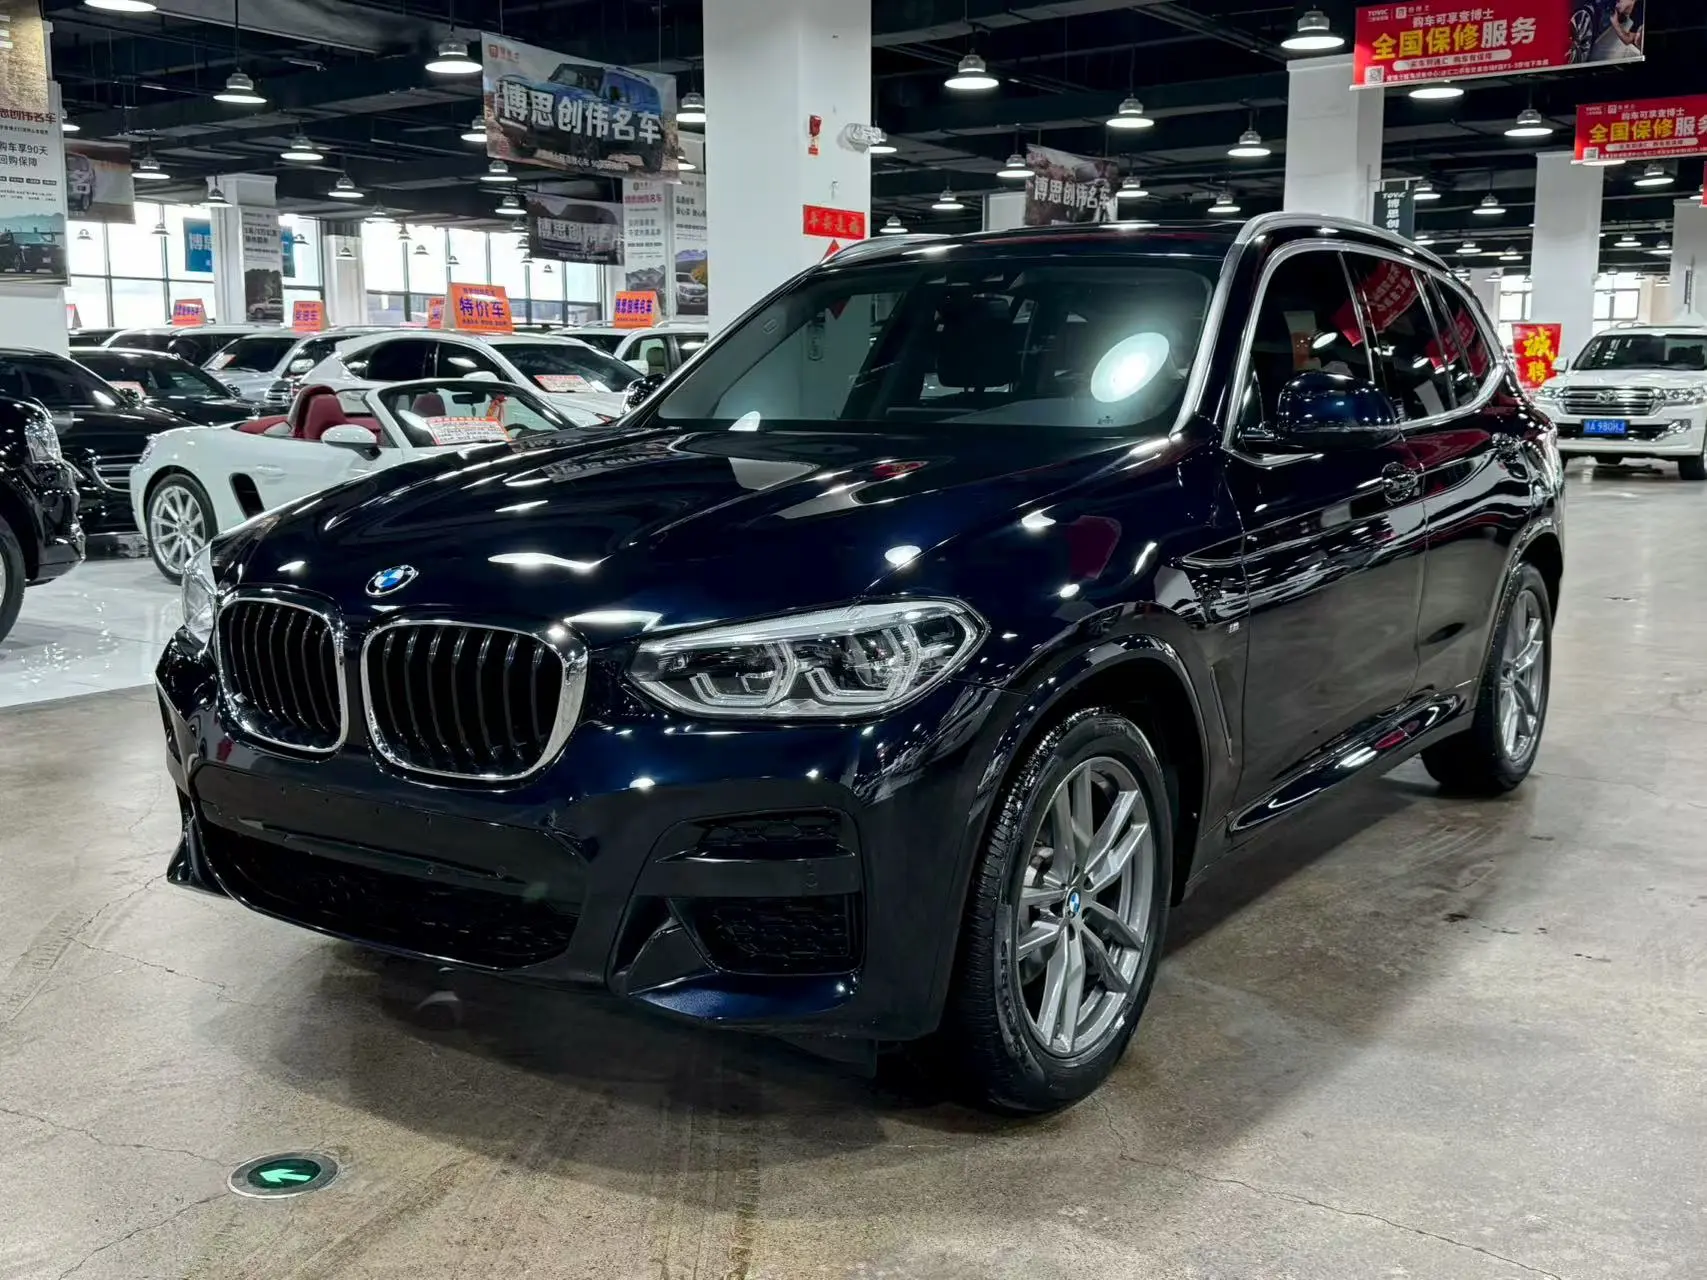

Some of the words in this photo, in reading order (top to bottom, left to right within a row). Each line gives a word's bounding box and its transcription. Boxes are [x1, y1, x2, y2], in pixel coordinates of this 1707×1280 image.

[1412, 8, 1494, 28] 购车可享查博士
[1372, 17, 1537, 60] 全国保修服务
[501, 79, 662, 144] 博思创伟名车
[1034, 173, 1111, 211] 博思创伟名车
[1386, 199, 1400, 235] 博思创
[459, 296, 505, 319] 特价车
